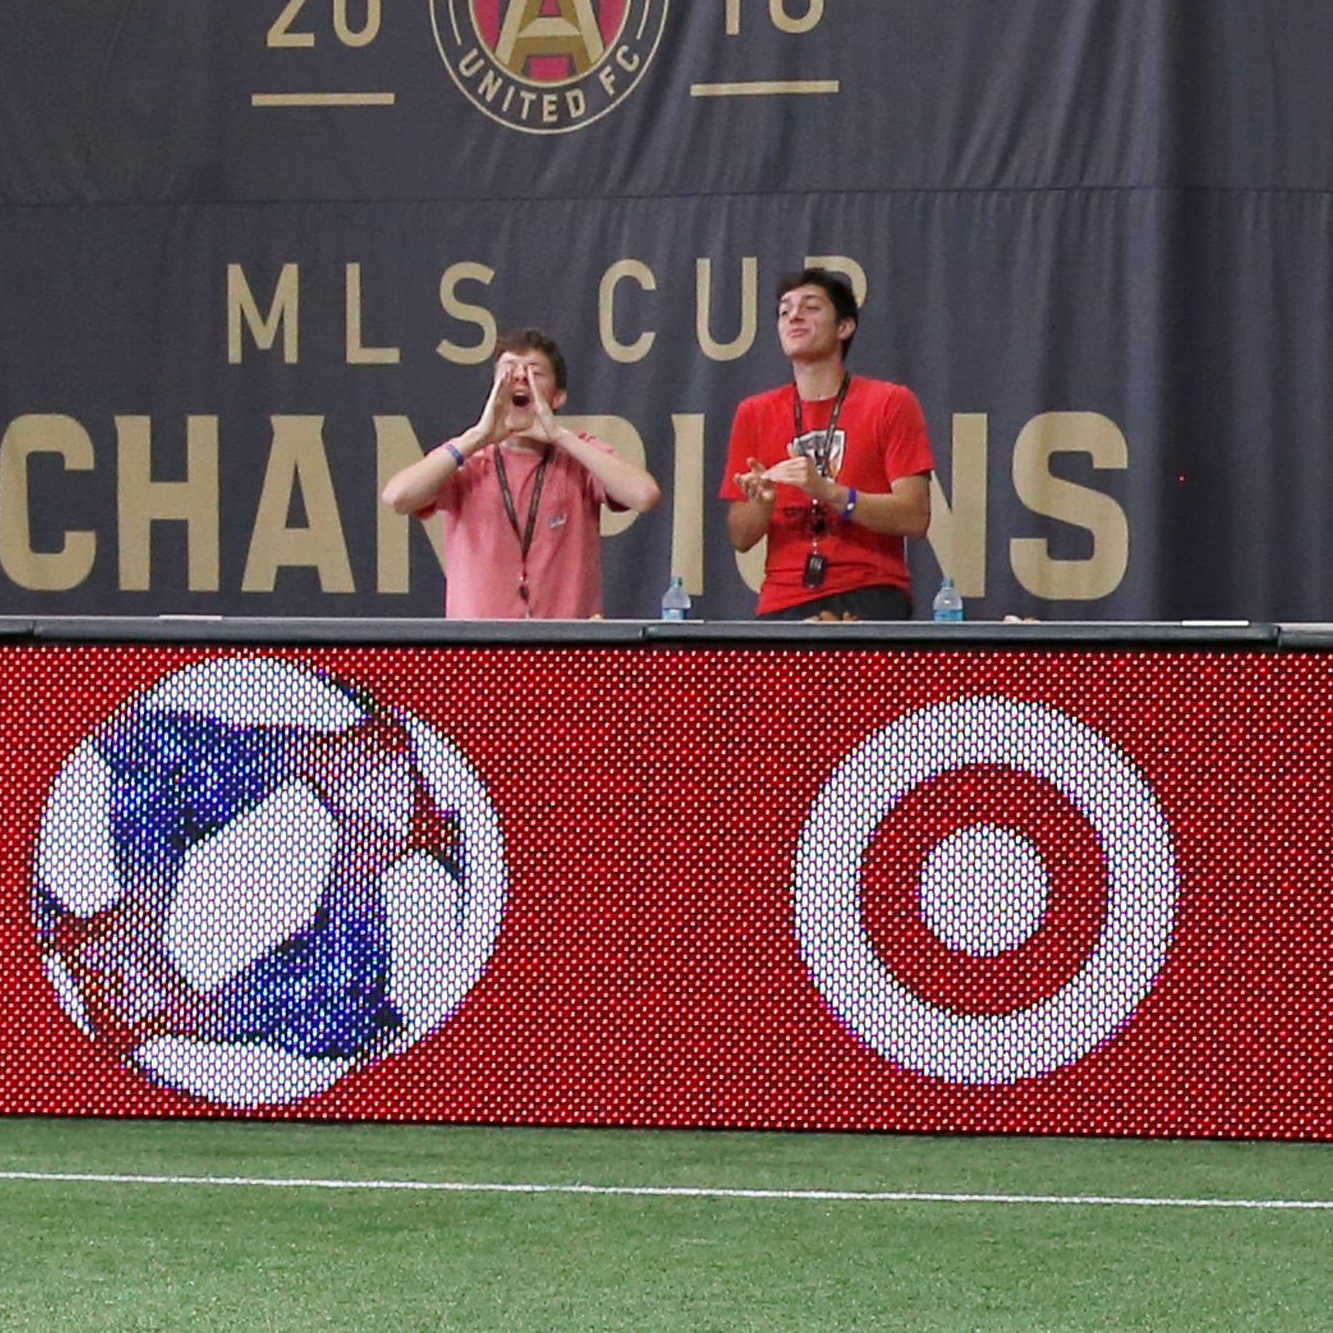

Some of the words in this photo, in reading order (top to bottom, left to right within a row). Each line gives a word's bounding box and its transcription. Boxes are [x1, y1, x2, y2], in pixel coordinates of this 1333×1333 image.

[458, 47, 586, 123] UNITED
[598, 44, 640, 97] FC
[227, 261, 498, 364] MLS
